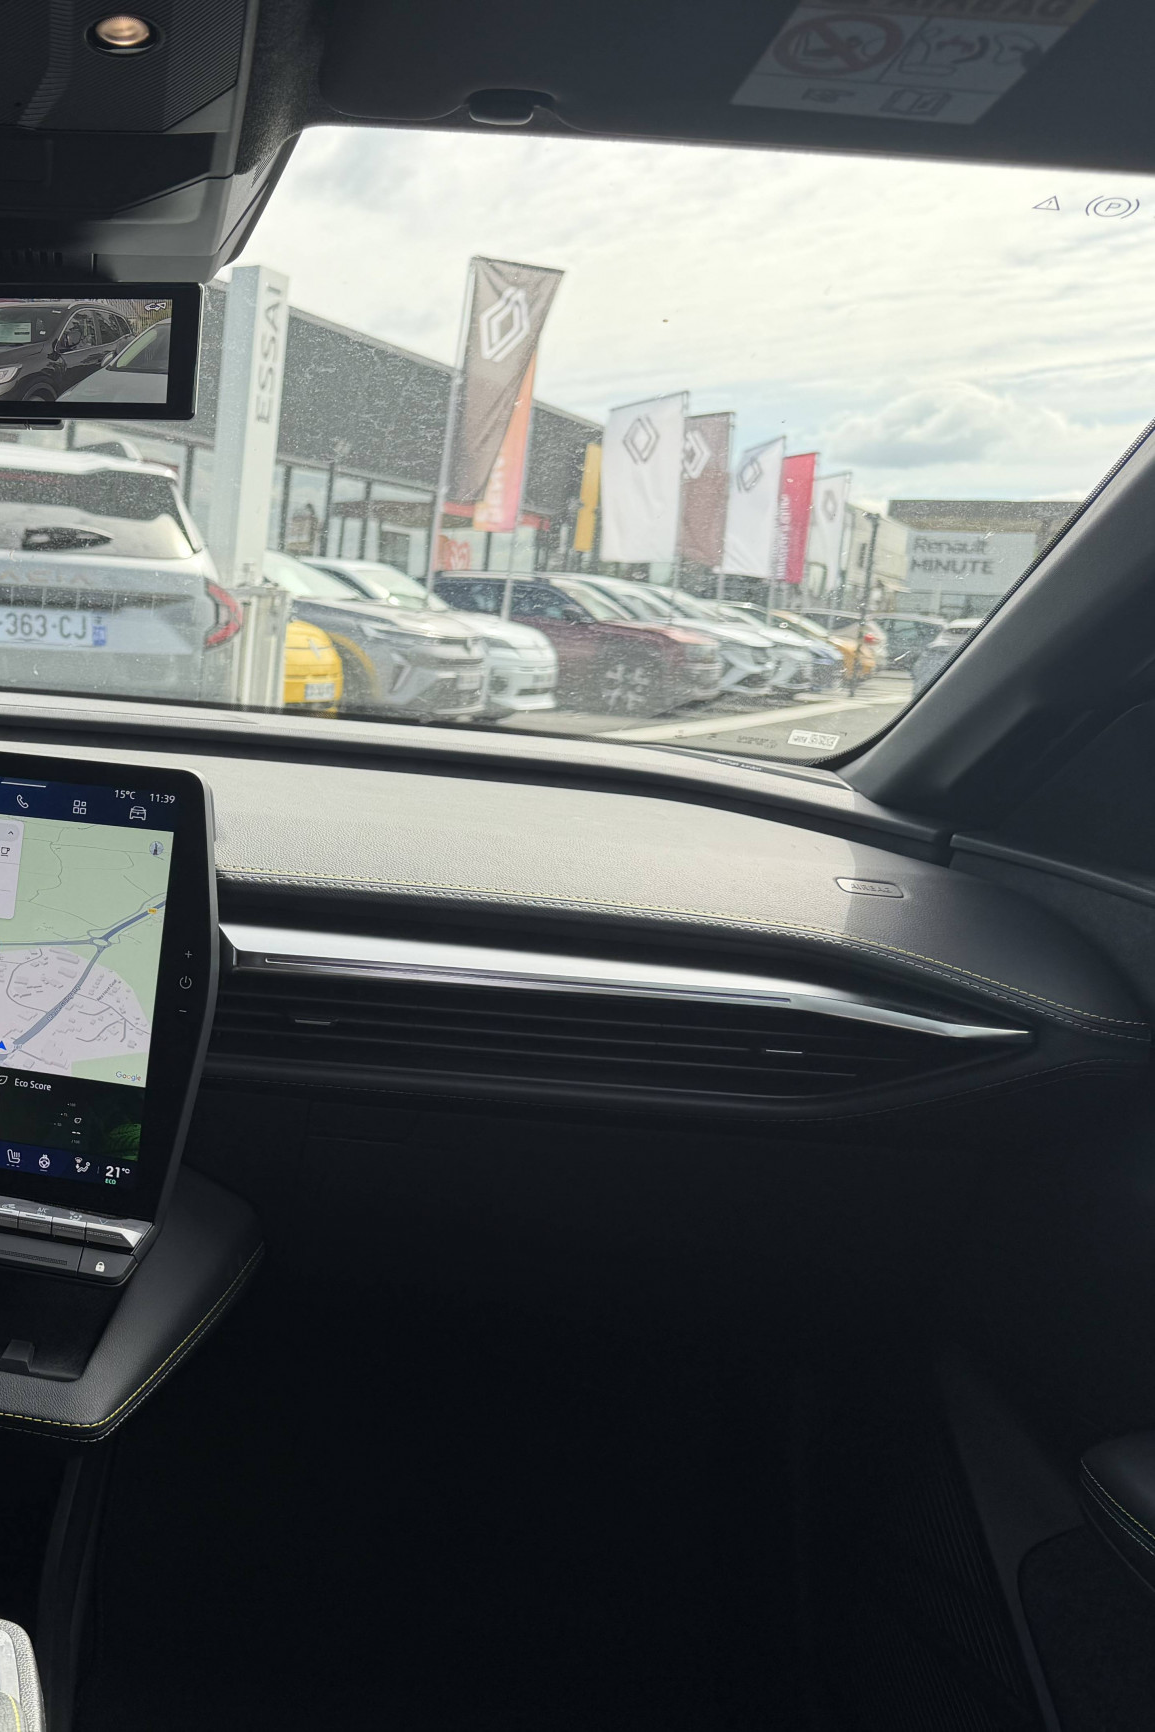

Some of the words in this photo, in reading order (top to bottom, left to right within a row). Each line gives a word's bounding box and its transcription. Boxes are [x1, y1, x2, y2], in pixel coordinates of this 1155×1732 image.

[256, 286, 282, 424] ESSAI
[914, 536, 989, 555] Renault
[911, 559, 995, 574] MINUTE
[114, 789, 136, 800] 15°C
[149, 793, 176, 804] 11:39
[115, 1070, 142, 1082] Google
[14, 1078, 29, 1087] Eco
[30, 1080, 52, 1091] Score
[105, 1165, 130, 1178] 21°C
[104, 1177, 116, 1185] ECO
